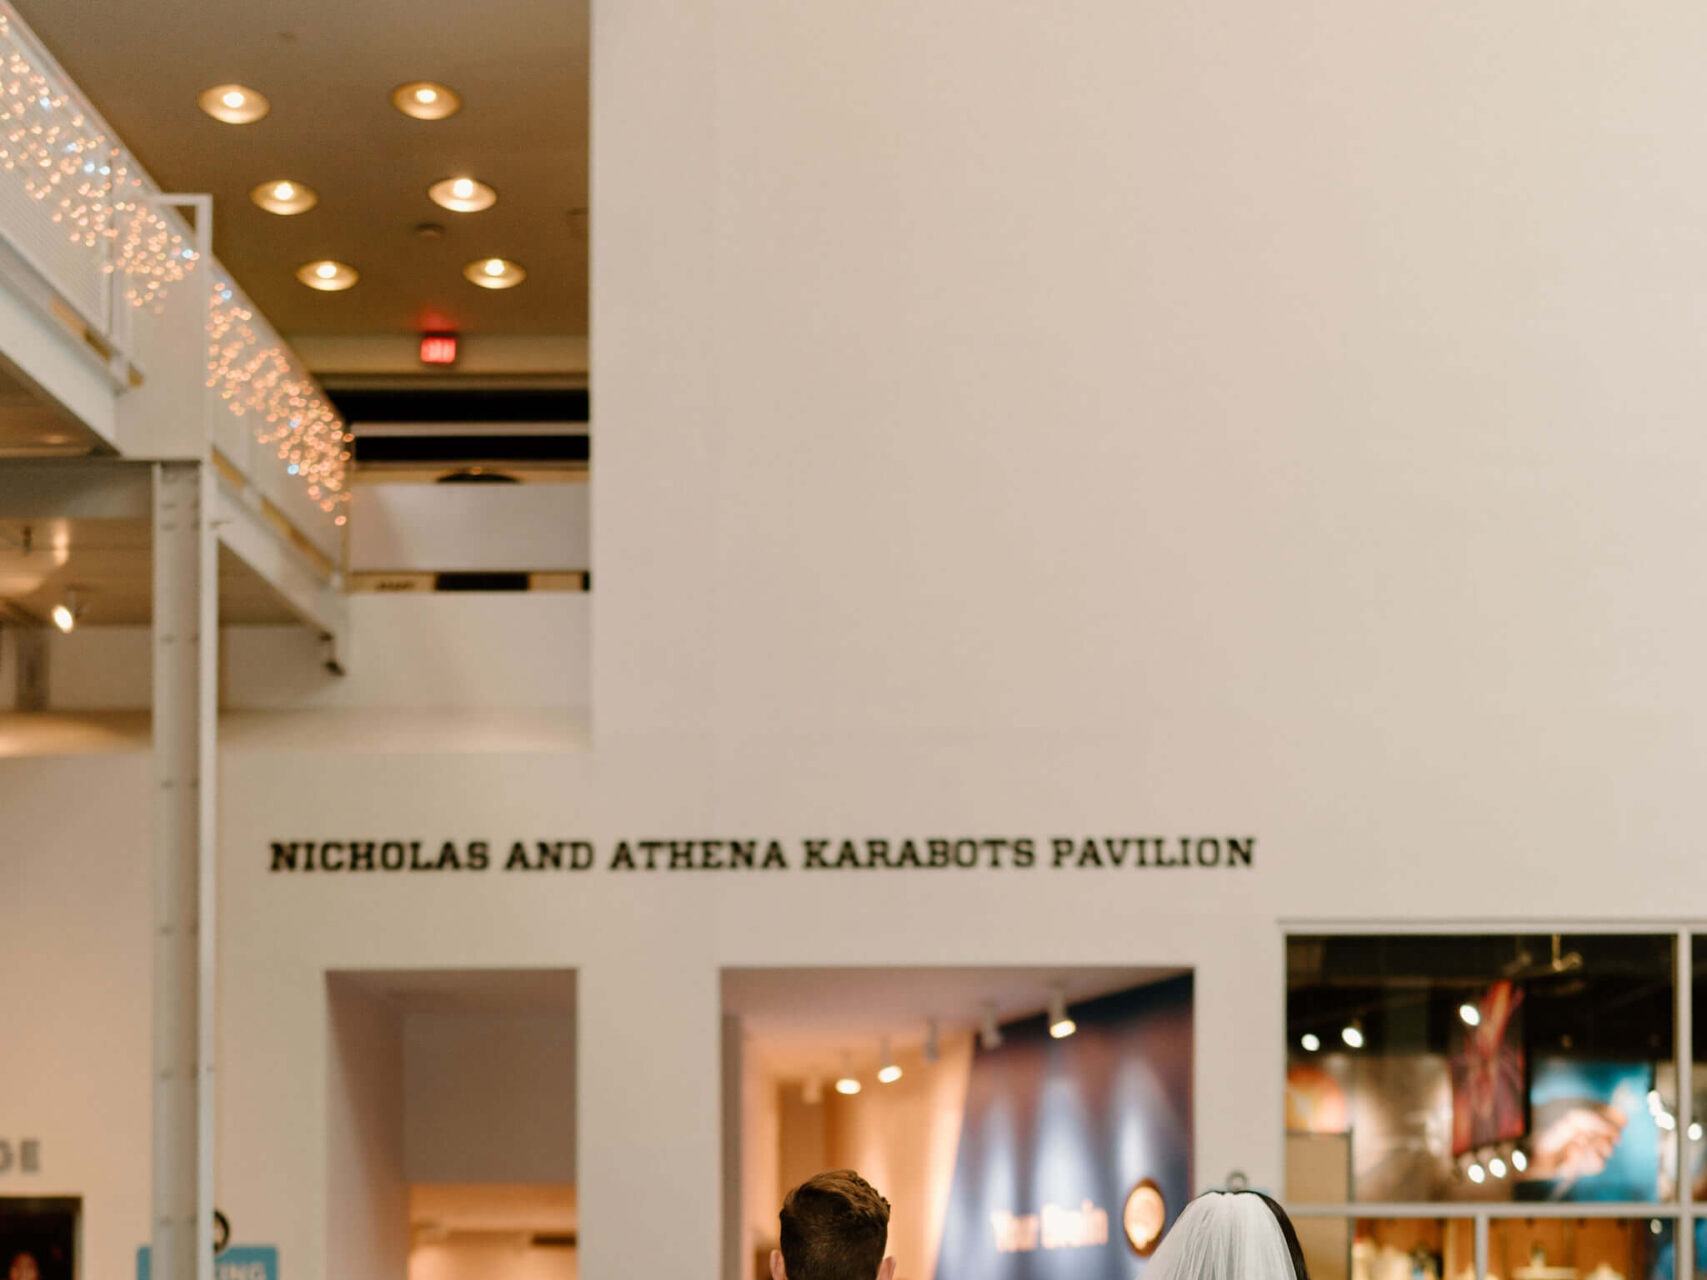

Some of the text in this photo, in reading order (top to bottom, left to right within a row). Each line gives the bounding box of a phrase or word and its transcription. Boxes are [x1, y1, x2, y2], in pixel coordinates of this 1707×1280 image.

[269, 838, 1254, 872] NICHOLAS AND ATHENA KARABOTS PAVILION
